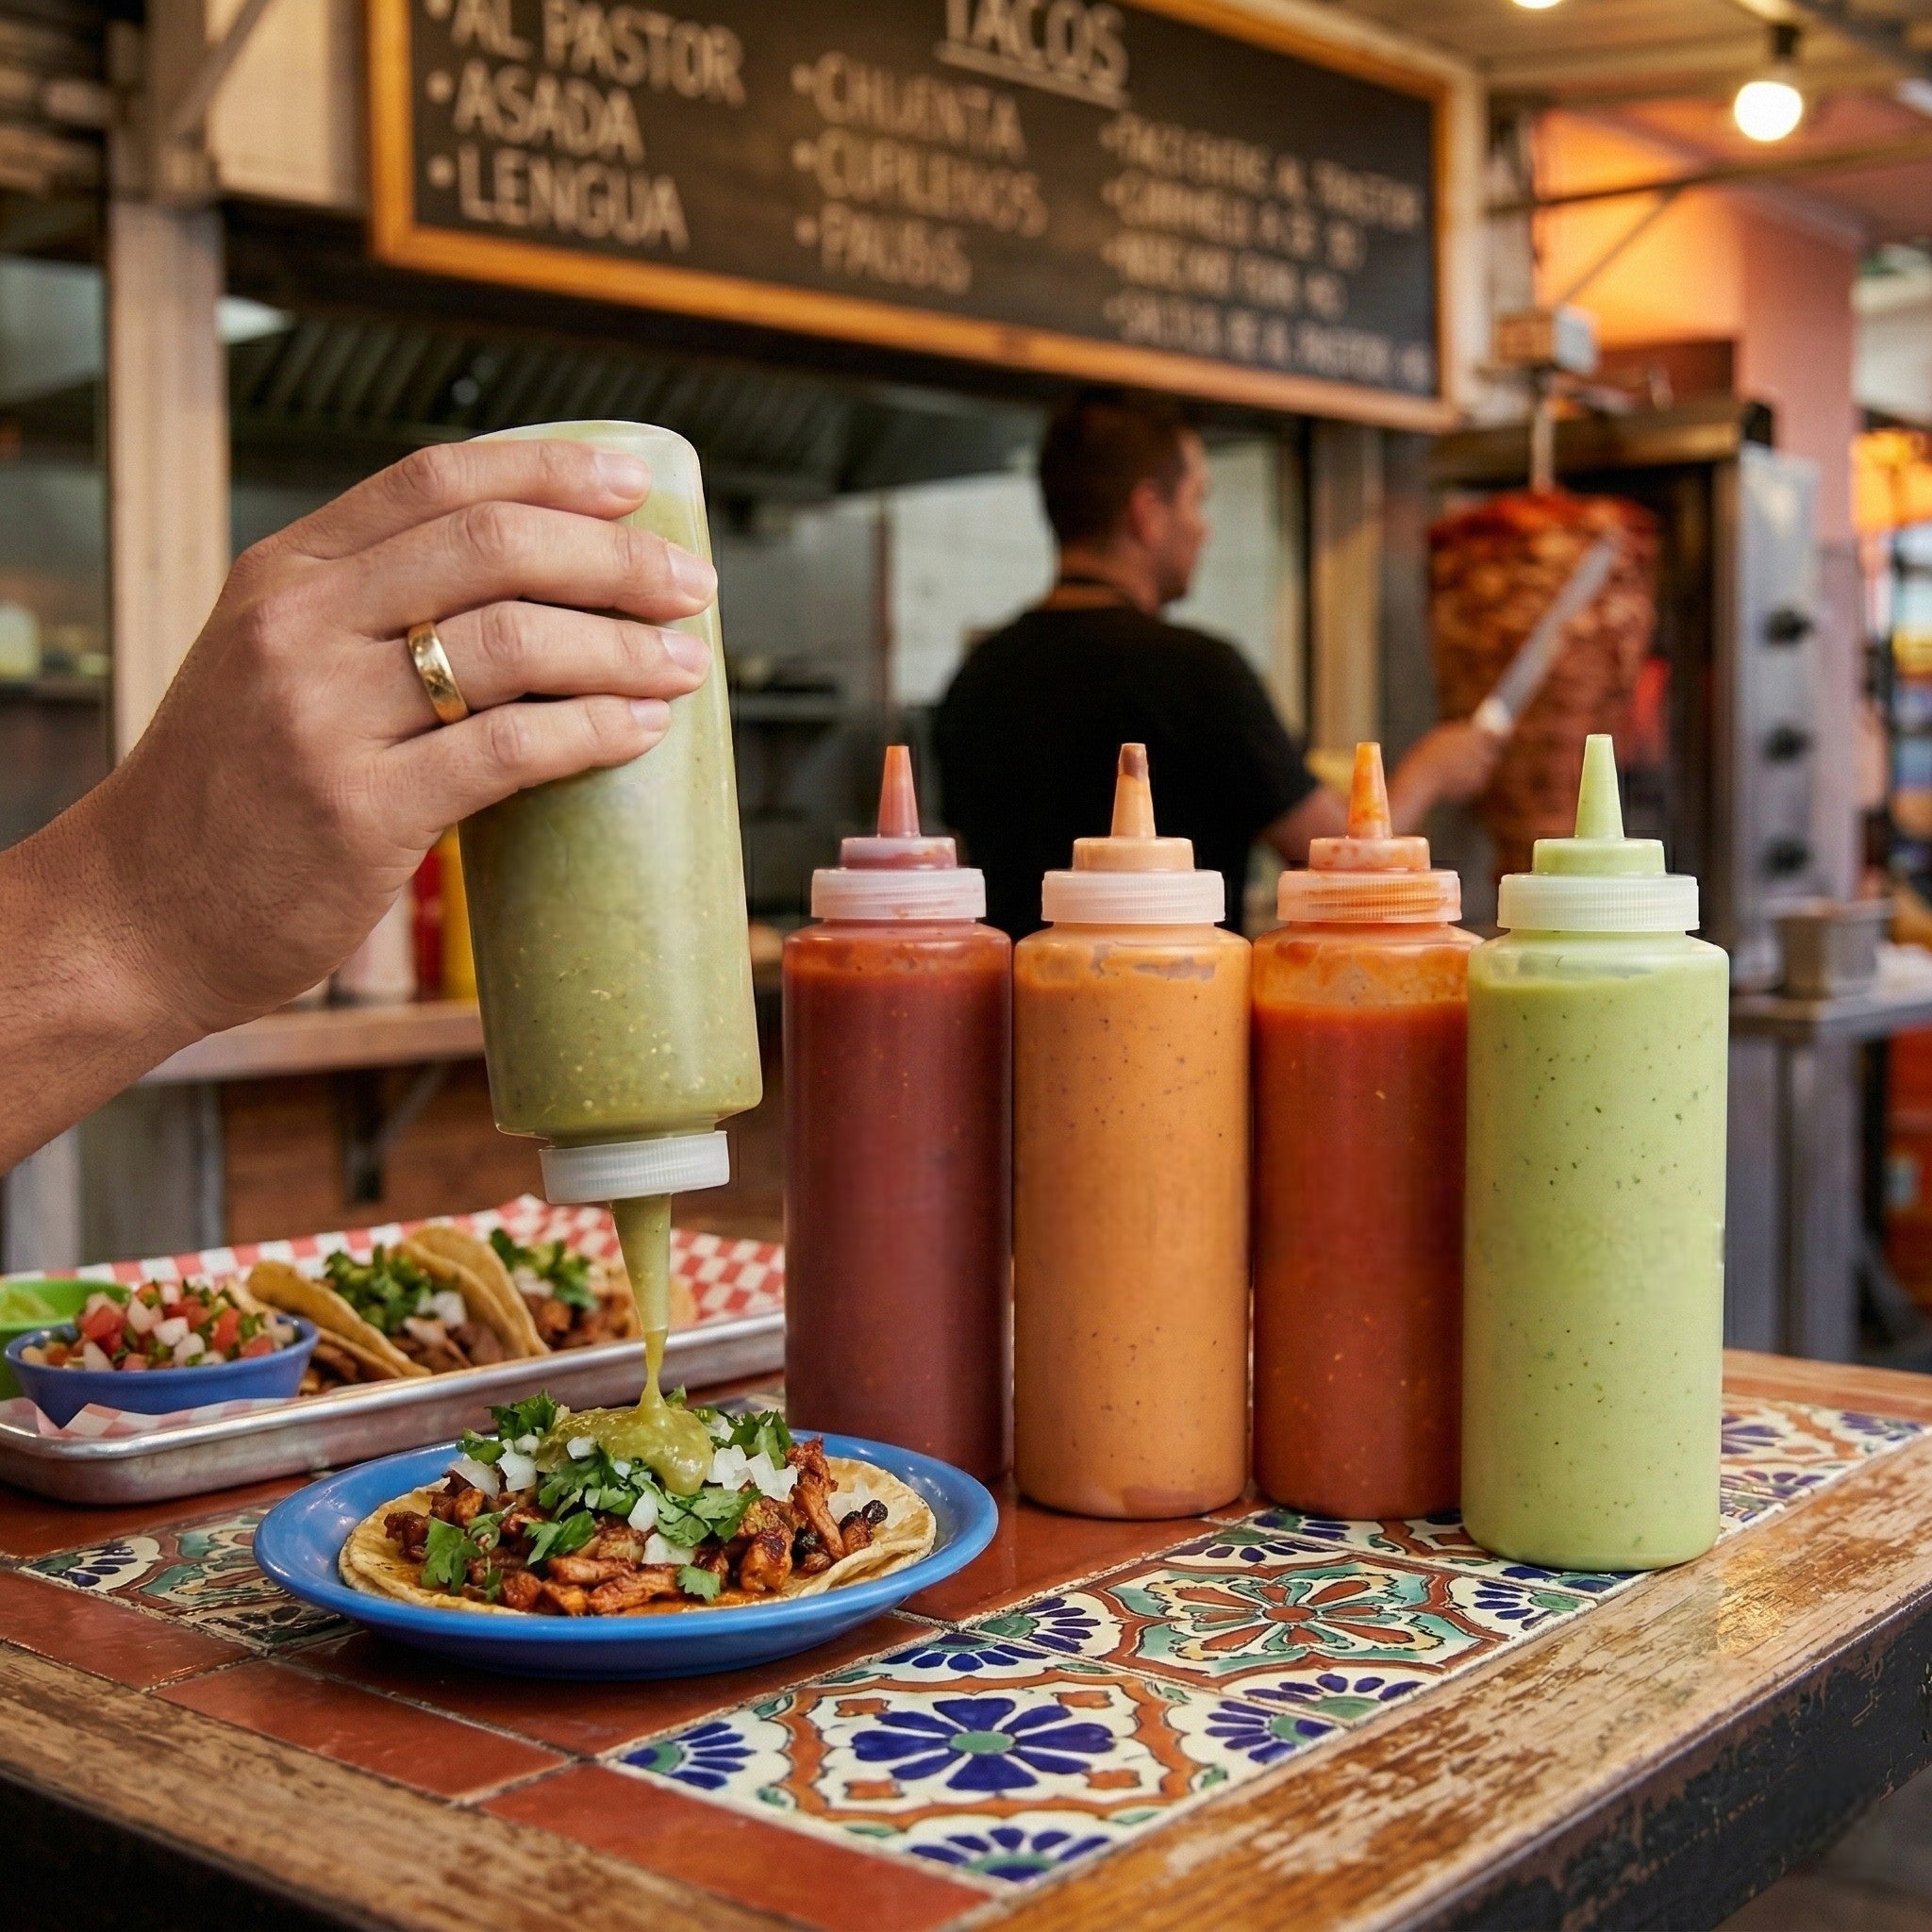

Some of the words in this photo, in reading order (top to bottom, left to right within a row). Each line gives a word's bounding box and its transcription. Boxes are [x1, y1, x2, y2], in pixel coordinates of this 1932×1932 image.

[451, 0, 534, 58] AL
[541, 0, 747, 108] PASTOR
[453, 58, 645, 165] ASADA
[458, 143, 690, 253] LENGUA
